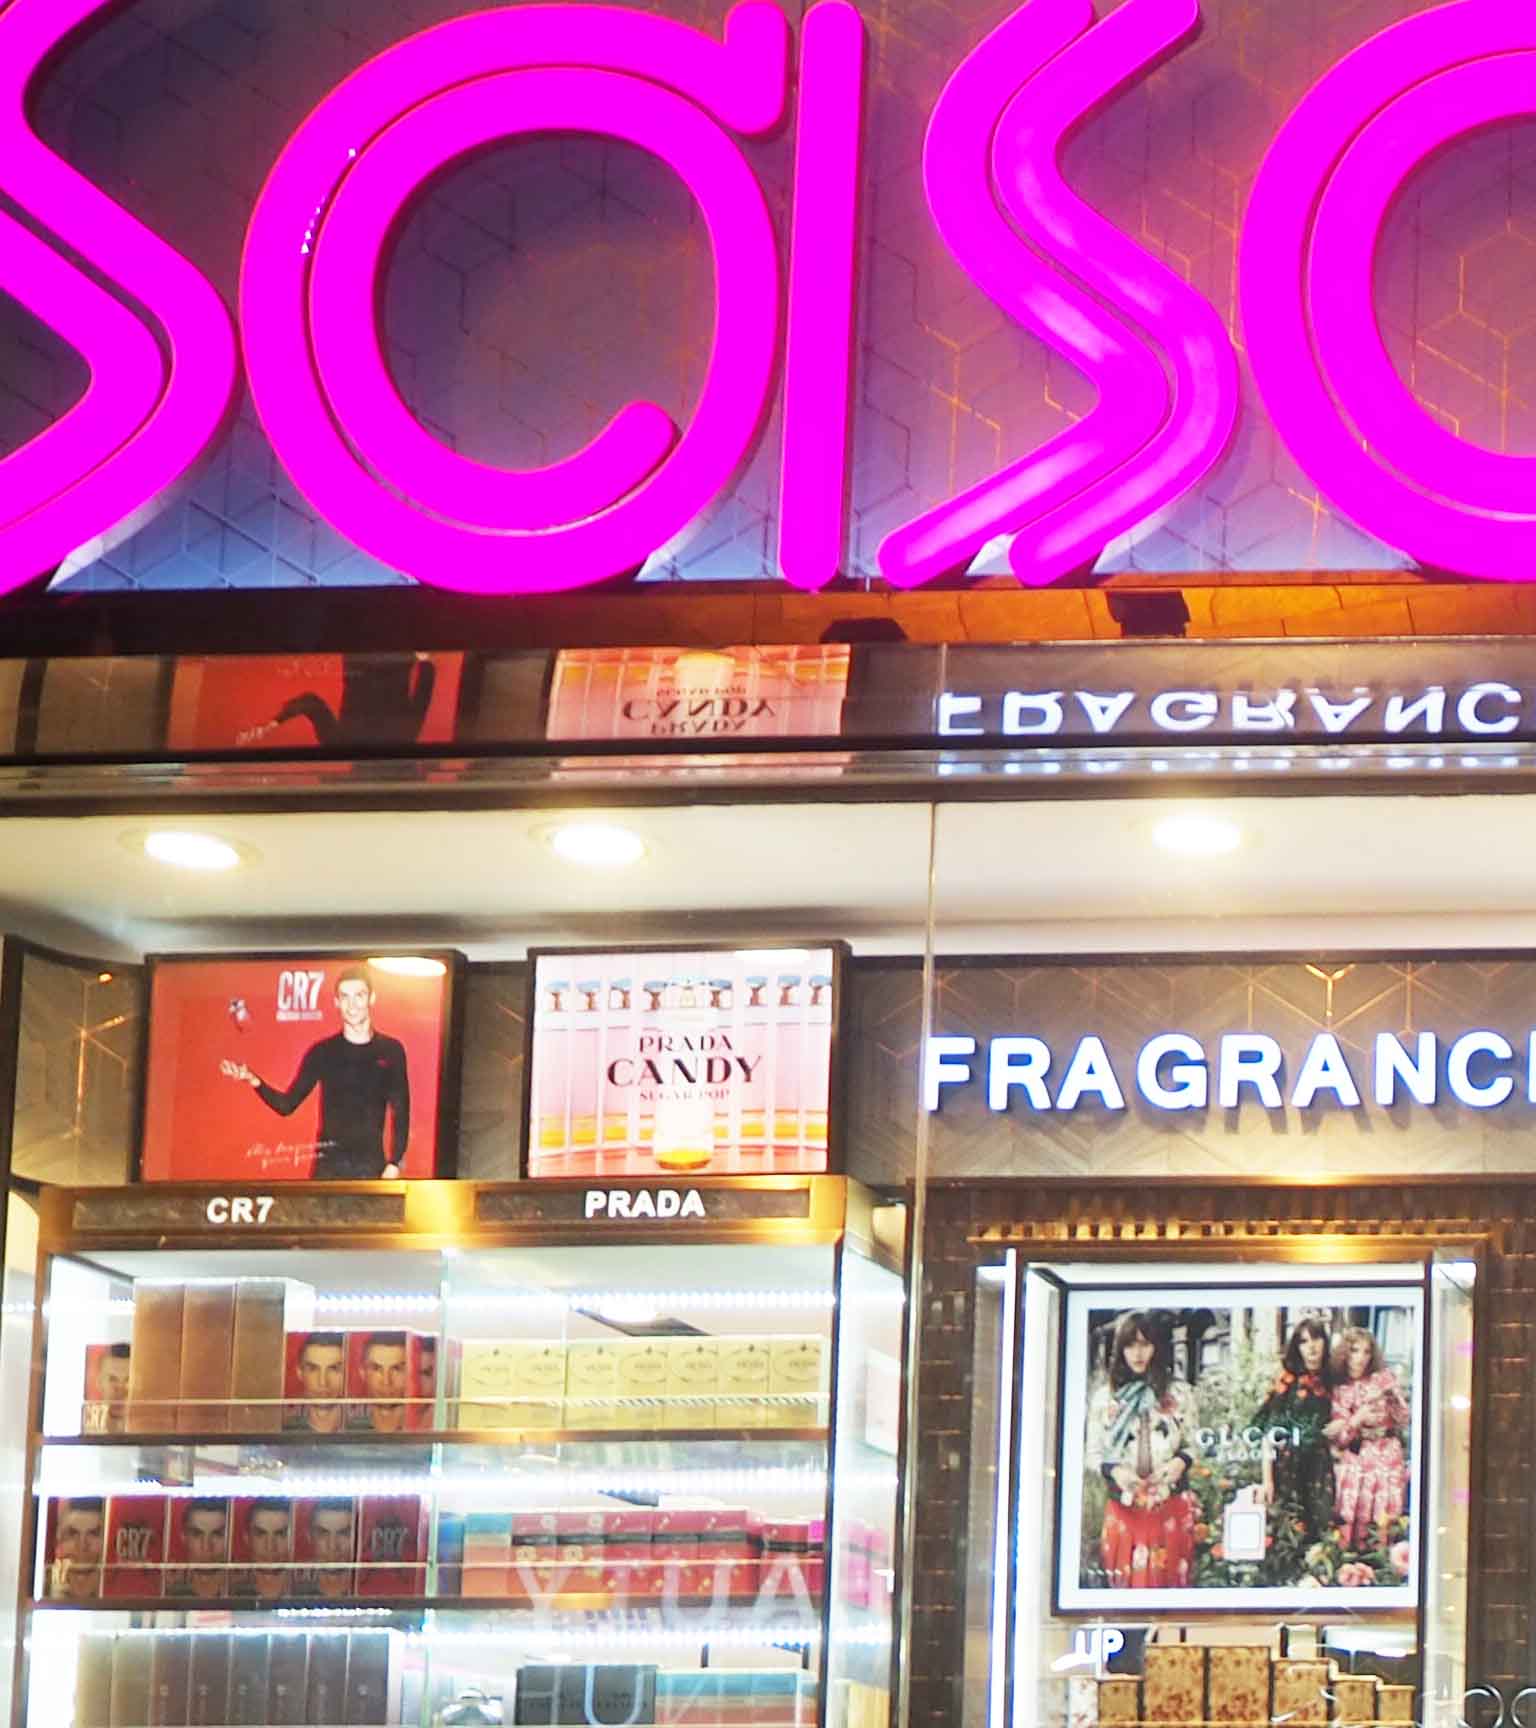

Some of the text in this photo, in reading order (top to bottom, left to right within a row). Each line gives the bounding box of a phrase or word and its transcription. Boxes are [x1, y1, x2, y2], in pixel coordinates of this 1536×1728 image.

[277, 968, 325, 1012] CR7
[639, 1035, 734, 1052] PRADA
[606, 1056, 762, 1087] CANDY
[206, 1197, 274, 1224] CR7
[584, 1190, 706, 1218] PRADA
[114, 1528, 155, 1560] CR7
